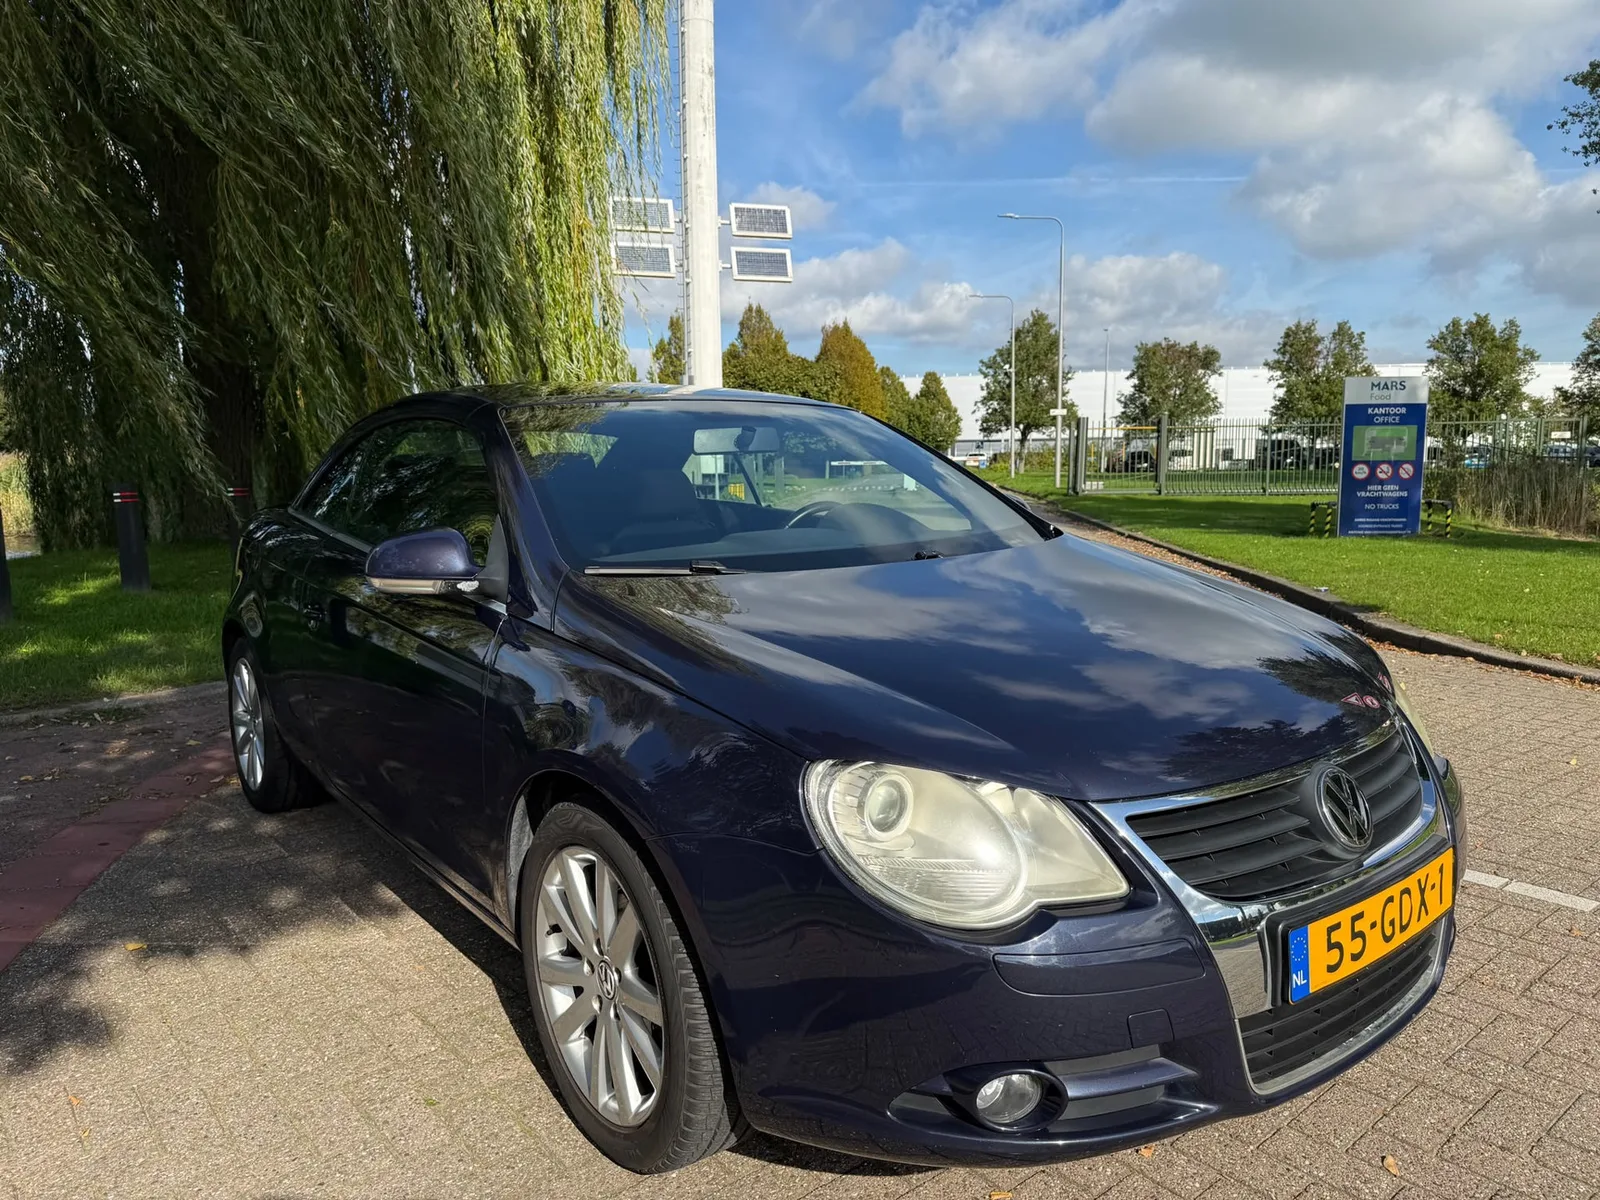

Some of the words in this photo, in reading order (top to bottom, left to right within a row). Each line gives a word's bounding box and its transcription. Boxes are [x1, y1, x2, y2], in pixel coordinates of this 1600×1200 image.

[1371, 381, 1406, 391] MARS
[1368, 407, 1406, 415] KANTOOR
[1326, 863, 1444, 973] 55-GDX-1
[1292, 970, 1307, 988] NL
